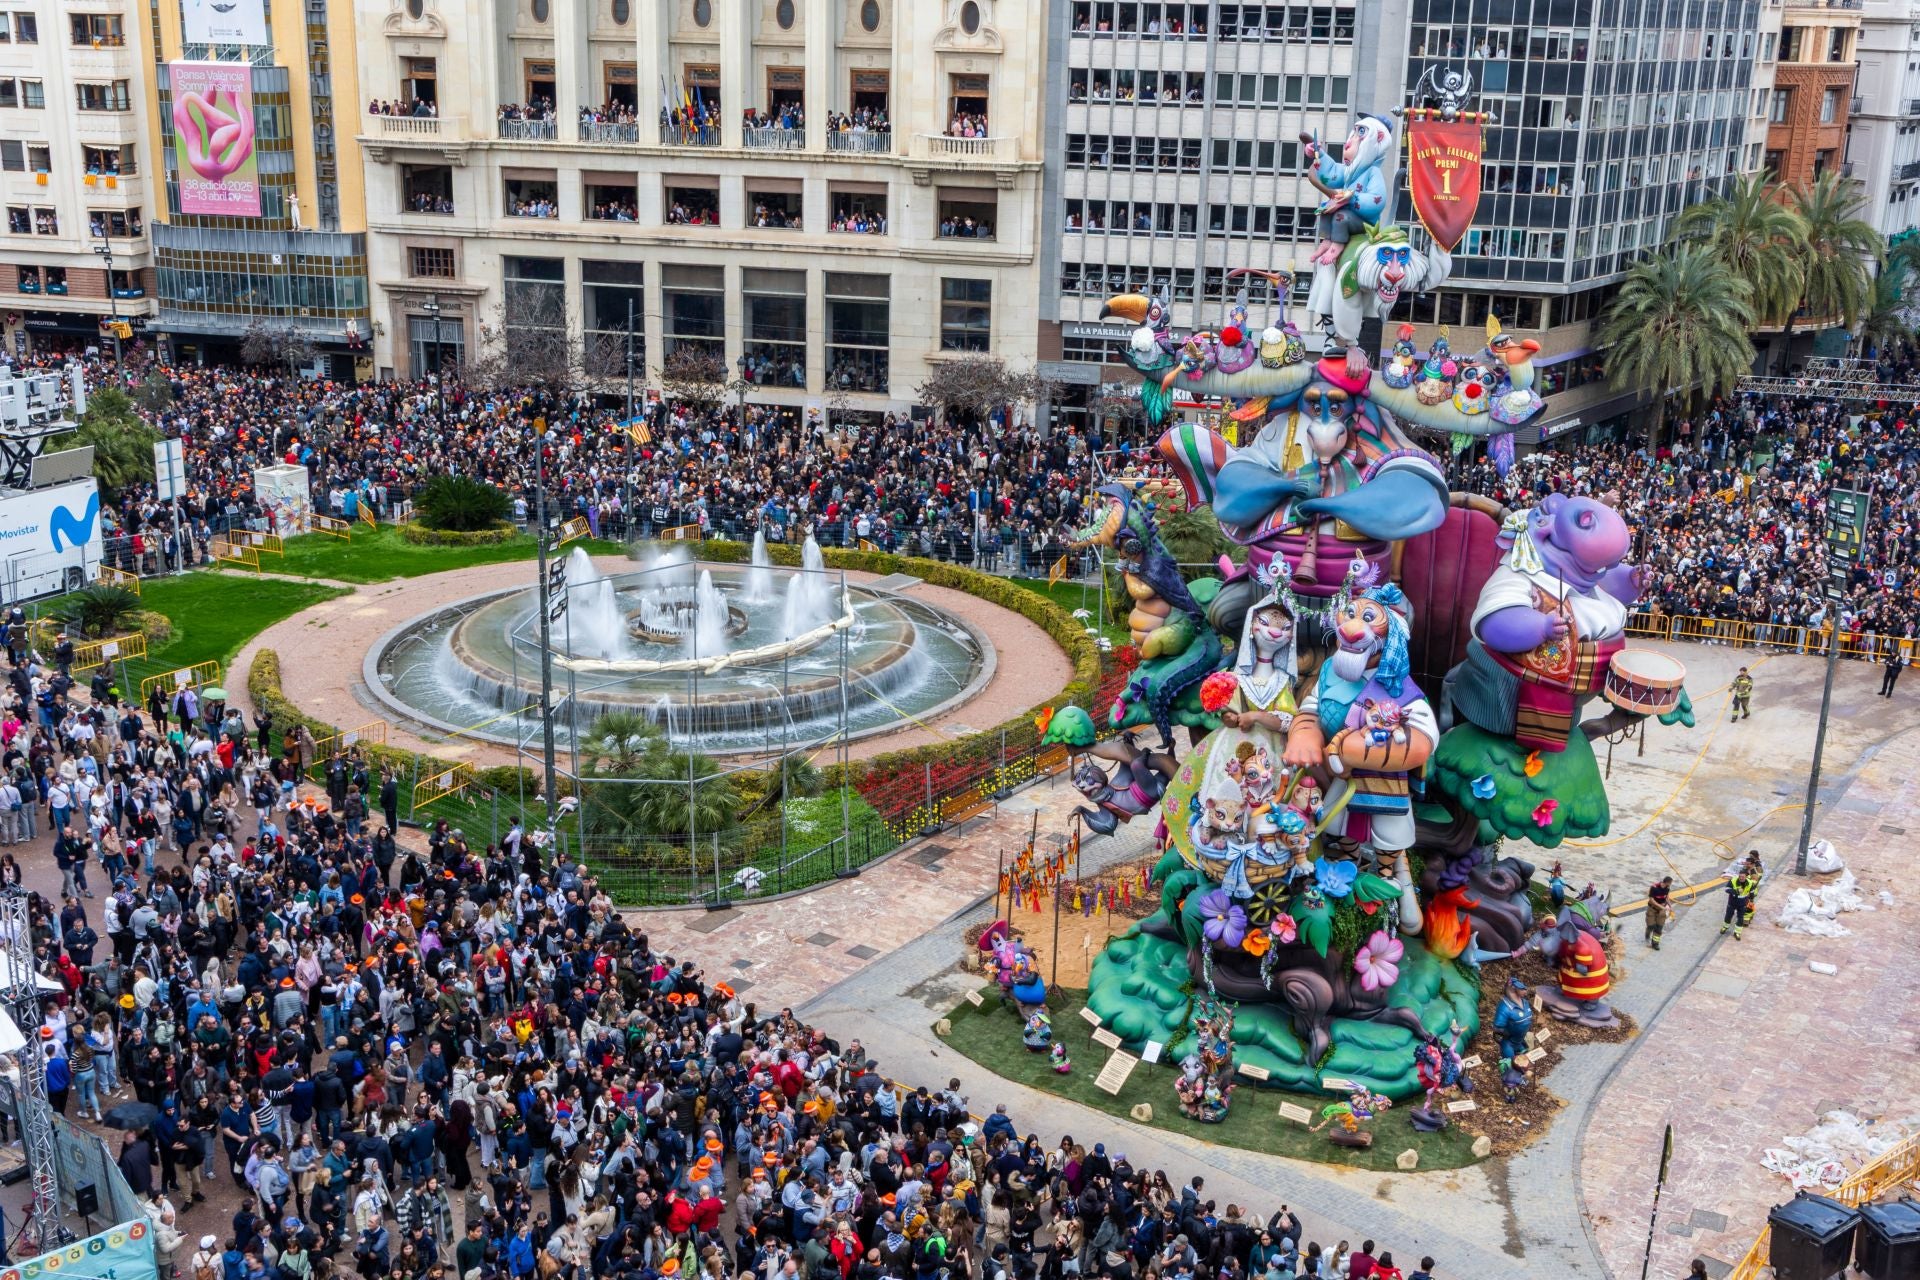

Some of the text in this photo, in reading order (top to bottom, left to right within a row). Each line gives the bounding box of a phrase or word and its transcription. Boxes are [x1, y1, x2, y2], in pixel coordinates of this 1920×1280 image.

[176, 69, 244, 81] Dansa València
[309, 40, 337, 232] FILMOTECA
[1417, 147, 1478, 163] FAUNA FALLERA
[1435, 159, 1459, 169] PREMI
[185, 179, 254, 193] 38 edició 2025
[1442, 169, 1451, 194] 1
[208, 191, 227, 201] abril
[1092, 328, 1133, 337] PARRILLA
[0, 525, 39, 540] Movistar
